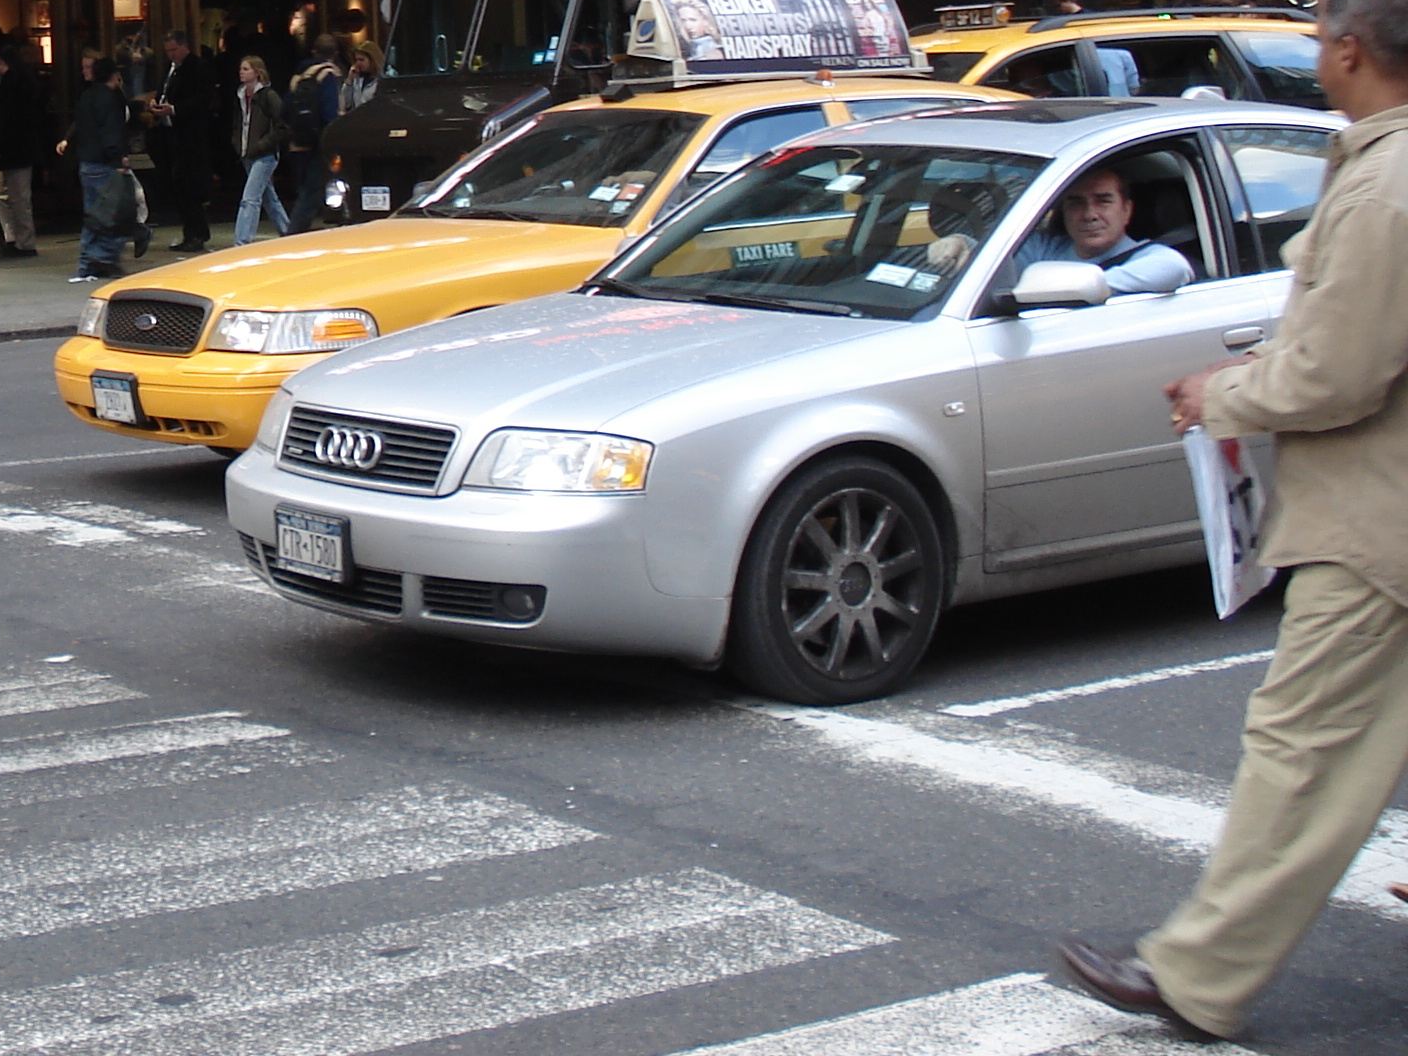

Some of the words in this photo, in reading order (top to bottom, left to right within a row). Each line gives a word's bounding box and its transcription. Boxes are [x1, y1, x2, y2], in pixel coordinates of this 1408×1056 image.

[715, 12, 811, 36] REINVENTS
[721, 34, 813, 59] HAIRSPRAY
[736, 245, 763, 261] TAXI
[764, 243, 795, 259] FARE
